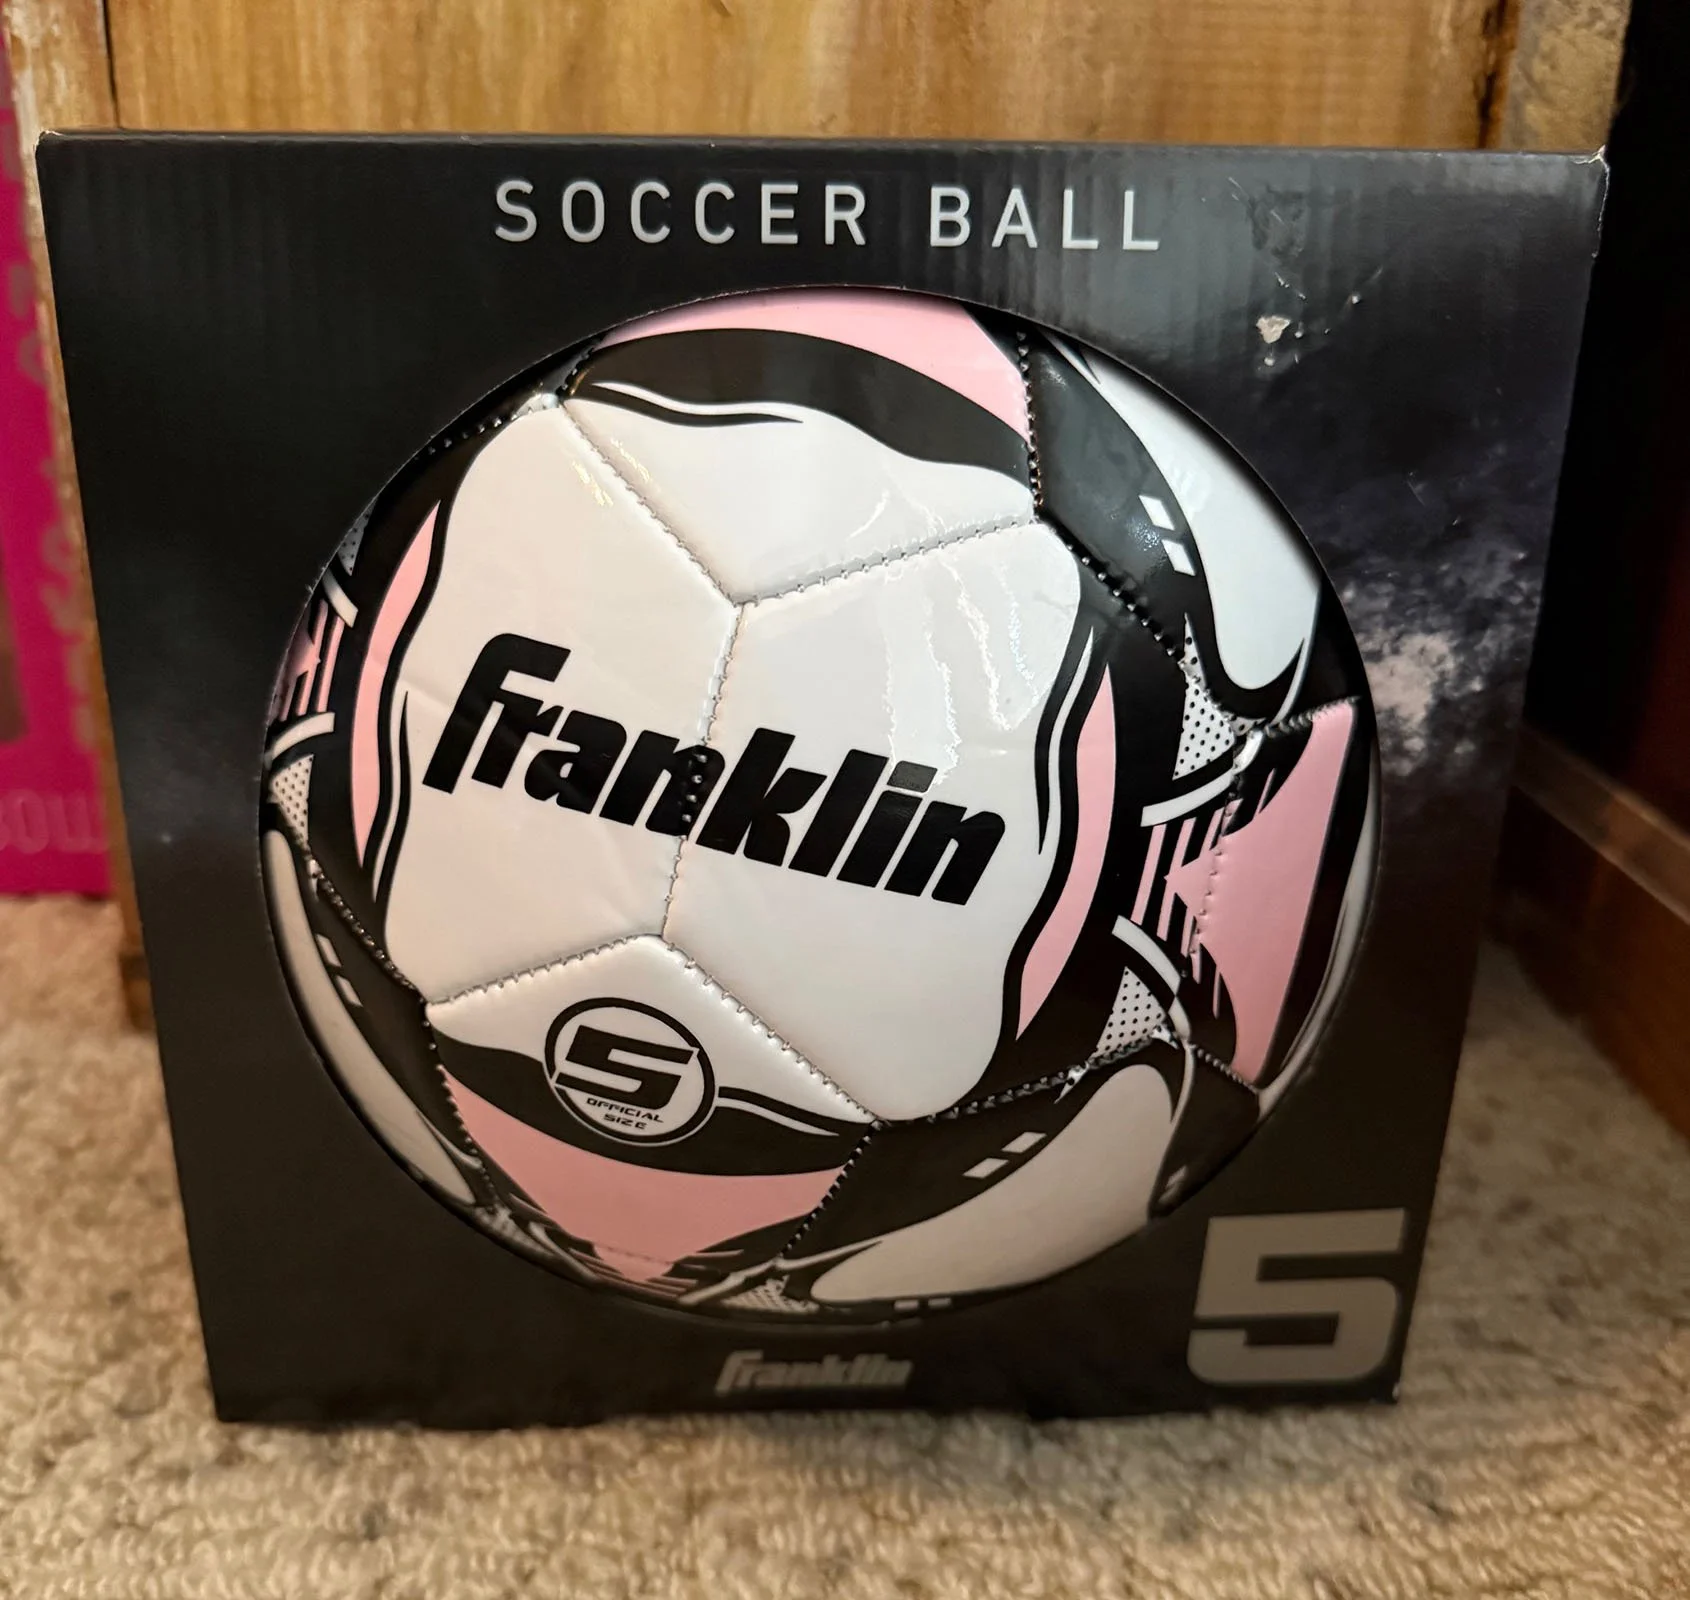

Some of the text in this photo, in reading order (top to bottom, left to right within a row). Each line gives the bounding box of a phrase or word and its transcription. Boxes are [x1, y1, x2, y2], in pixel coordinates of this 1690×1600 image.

[494, 179, 1160, 252] SOCCER BALL
[555, 1024, 694, 1110] 5
[586, 1096, 664, 1124] OFFICIAL
[603, 1113, 648, 1130] SIZE
[1186, 1207, 1406, 1383] 5
